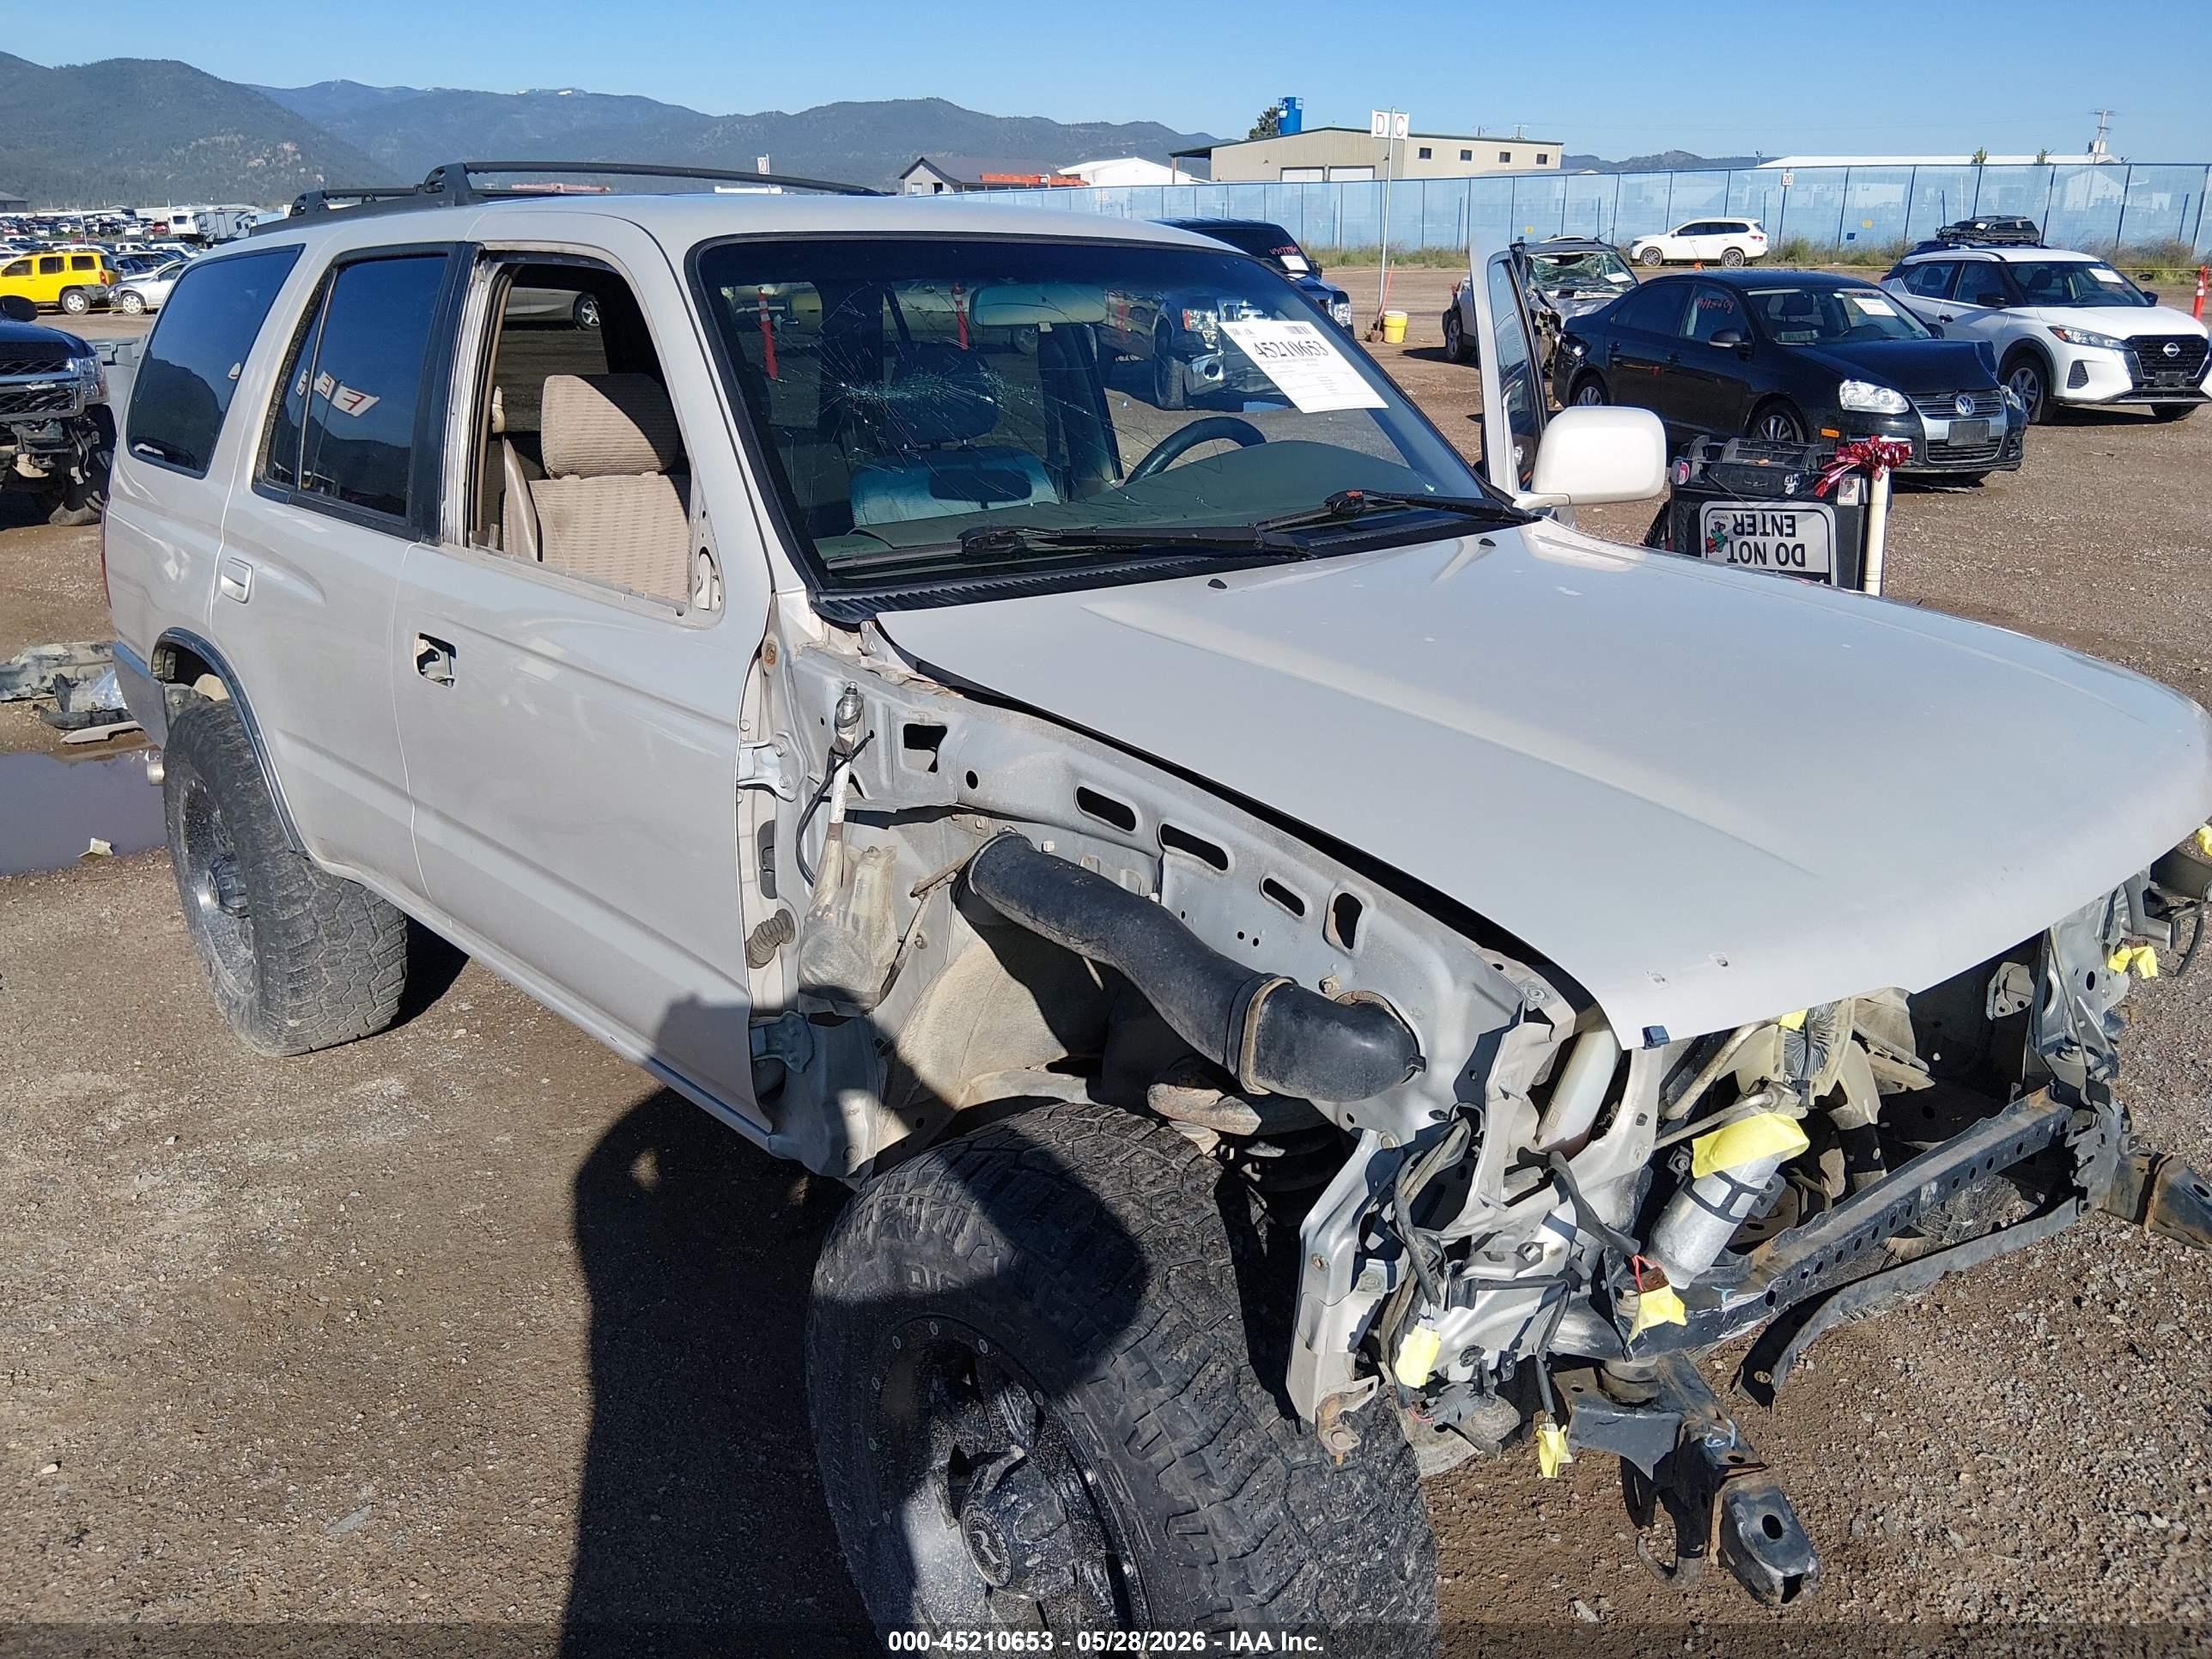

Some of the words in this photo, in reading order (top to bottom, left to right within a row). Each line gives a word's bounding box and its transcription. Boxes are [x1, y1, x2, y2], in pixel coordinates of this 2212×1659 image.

[1376, 113, 1385, 135] D
[1395, 115, 1405, 137] C
[1254, 340, 1328, 358] 45210653
[1733, 513, 1796, 538] ENTER
[1727, 540, 1767, 565] NOT
[1776, 543, 1806, 568] DO
